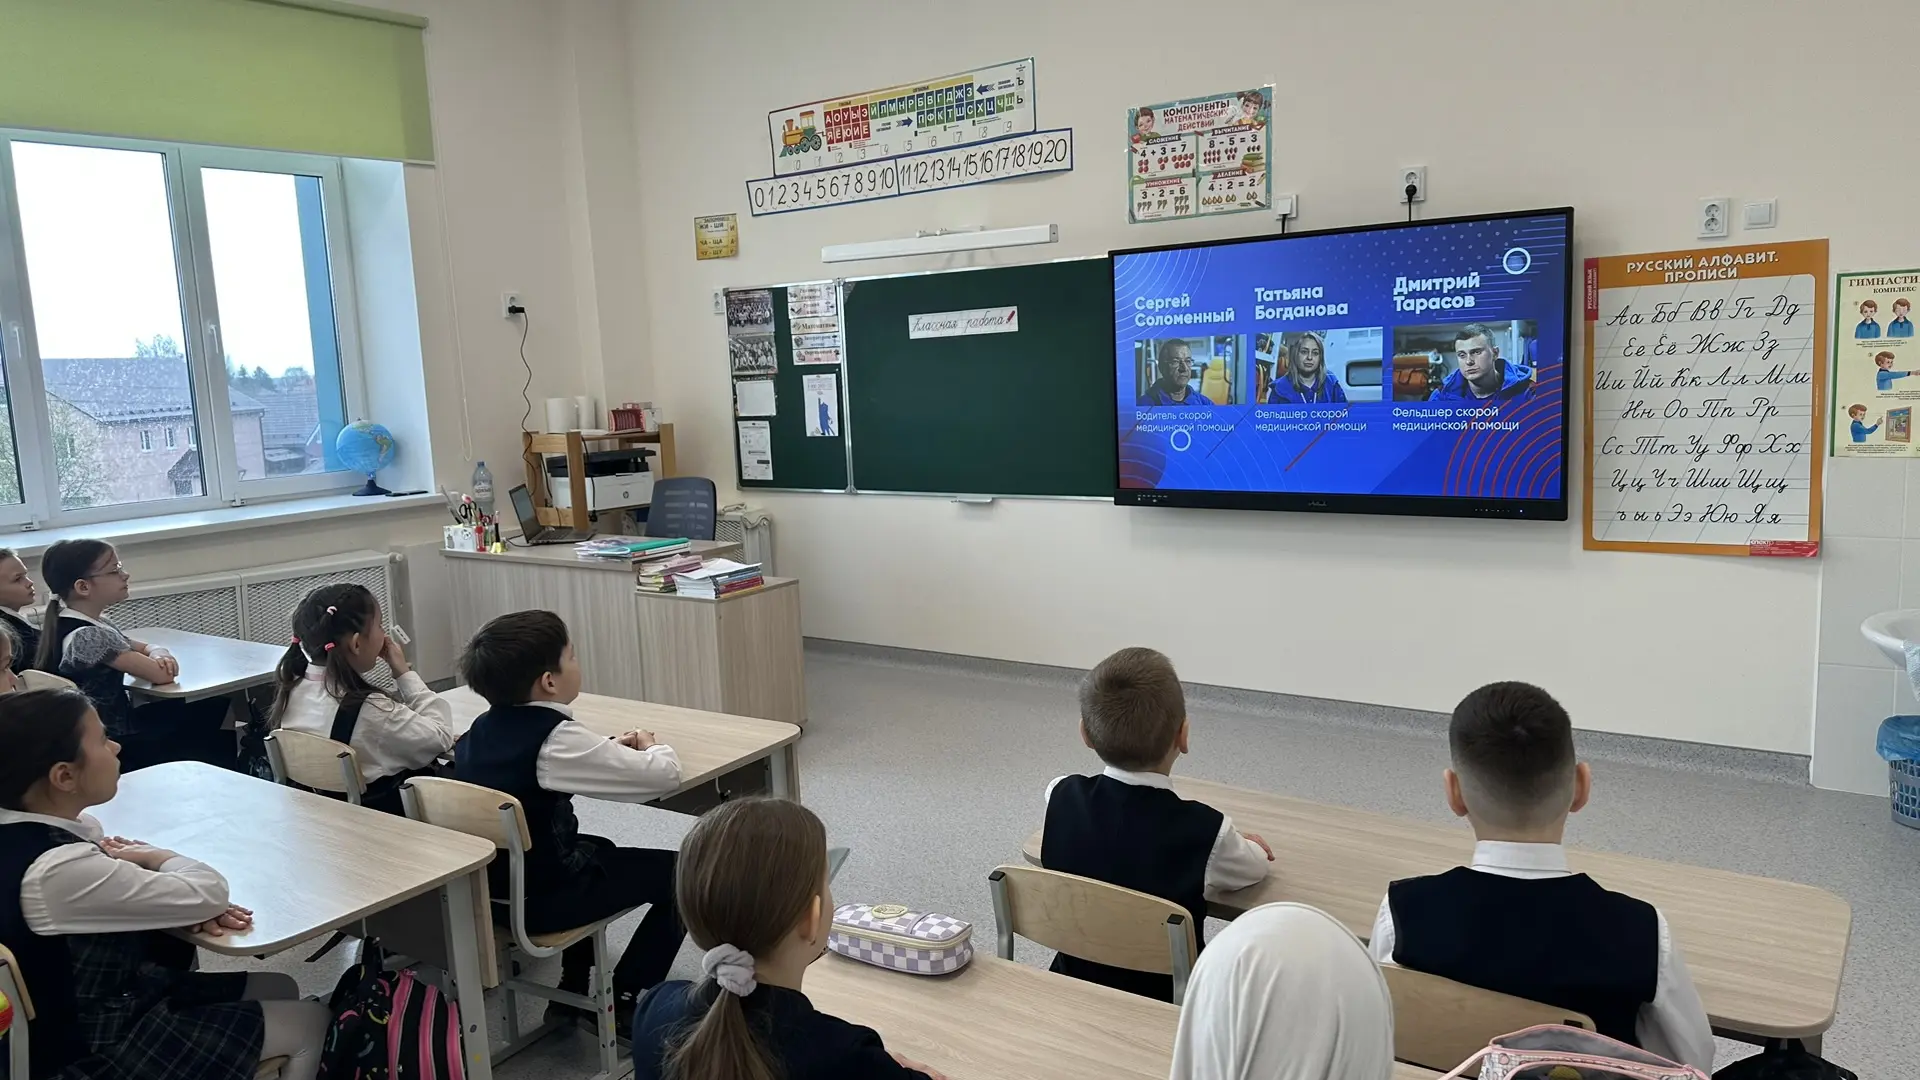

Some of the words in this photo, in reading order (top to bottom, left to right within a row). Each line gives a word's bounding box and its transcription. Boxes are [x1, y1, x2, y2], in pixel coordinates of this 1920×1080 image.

[1164, 100, 1229, 117] КОМПОНЕНТЫ
[1164, 108, 1228, 124] МАТЕМАТИЧЕСКИХ
[1178, 120, 1214, 132] ДЕЙСТВИЙ
[1214, 125, 1250, 134] ВЫЧИТАНИЕ
[1149, 135, 1178, 143] СЛОЖЕНИЕ
[1209, 140, 1215, 148] 8
[1229, 137, 1234, 145] 5
[1251, 134, 1257, 142] 3
[1161, 147, 1166, 155] 3
[900, 164, 911, 186] 11
[914, 162, 928, 184] 12
[931, 159, 945, 181] 13
[947, 157, 961, 179] 14
[964, 154, 977, 176] 15
[980, 150, 993, 174] 16
[996, 147, 1010, 171] 17
[1012, 144, 1025, 168] 18
[1028, 141, 1043, 165] 19
[1044, 139, 1068, 163] 20
[755, 188, 764, 207] 0
[768, 186, 773, 206] 1
[778, 185, 786, 204] 2
[791, 182, 799, 202] 3
[804, 181, 811, 200] 4
[816, 178, 826, 199] 5
[830, 176, 839, 197] 6
[842, 174, 850, 195] 7
[855, 172, 863, 193] 8
[867, 170, 876, 191] 9
[880, 167, 894, 189] 10
[1147, 179, 1180, 187] УМНОЖЕНИЕ
[1227, 181, 1233, 189] 2
[1627, 256, 1693, 273] РУССКИЙ
[1698, 251, 1779, 268] АЛФАВИТ.
[1664, 267, 1737, 283] ПРОПИСИ
[1849, 276, 1920, 287] ГИМНАСТИ
[1393, 272, 1480, 295] Дмитрий
[1254, 286, 1323, 302] Татьяна
[1134, 294, 1190, 312] Сергей
[1255, 302, 1348, 320] Богданова
[1393, 295, 1475, 314] Тарасов
[1606, 304, 1644, 326] Аа
[1651, 300, 1693, 323] Бб
[1690, 298, 1724, 322] Вв
[1728, 297, 1755, 319] Гг
[1765, 295, 1800, 326] Дд
[911, 316, 958, 332] Классная
[1134, 308, 1235, 327] Соломенный
[1623, 337, 1646, 357] Ее
[1653, 334, 1676, 356] Ёё
[1686, 333, 1746, 354] Жж
[1752, 330, 1780, 360] Зз
[1596, 370, 1626, 390] Ии
[1633, 365, 1664, 389] Йй
[1670, 368, 1702, 387] Кк
[1708, 366, 1749, 386] Лл
[1754, 363, 1810, 385] Мм
[1136, 411, 1177, 422] Водитель
[1179, 411, 1212, 422] скорой
[1255, 410, 1307, 421] Фельдшер
[1310, 409, 1349, 420] скорой
[1392, 407, 1452, 419] Фельдшер
[1456, 407, 1499, 418] скорой
[1621, 401, 1655, 419] Нн
[1663, 399, 1688, 418] Оо
[1696, 398, 1736, 418] Пп
[1746, 397, 1779, 424] Рр
[1136, 423, 1195, 433] медицинской
[1197, 424, 1235, 433] помощи
[1255, 422, 1321, 432] медицинской
[1324, 423, 1367, 432] помощи
[1392, 421, 1467, 431] медицинской
[1470, 422, 1520, 432] помощи
[1601, 436, 1624, 455] Сс
[1630, 436, 1678, 454] Тт
[1685, 434, 1710, 462] Уу
[1716, 434, 1752, 462] Фф
[1759, 434, 1801, 454] Хх
[1610, 469, 1646, 492] Цц
[1652, 468, 1679, 488] Чч
[1686, 468, 1731, 488] Шш
[1737, 469, 1789, 493] Щщ
[1617, 510, 1626, 521] ъ
[1634, 511, 1648, 521] ы
[1654, 512, 1661, 521] ь
[1667, 503, 1693, 522] Ээ
[1699, 503, 1739, 523] Юю
[1745, 503, 1782, 524] Яя
